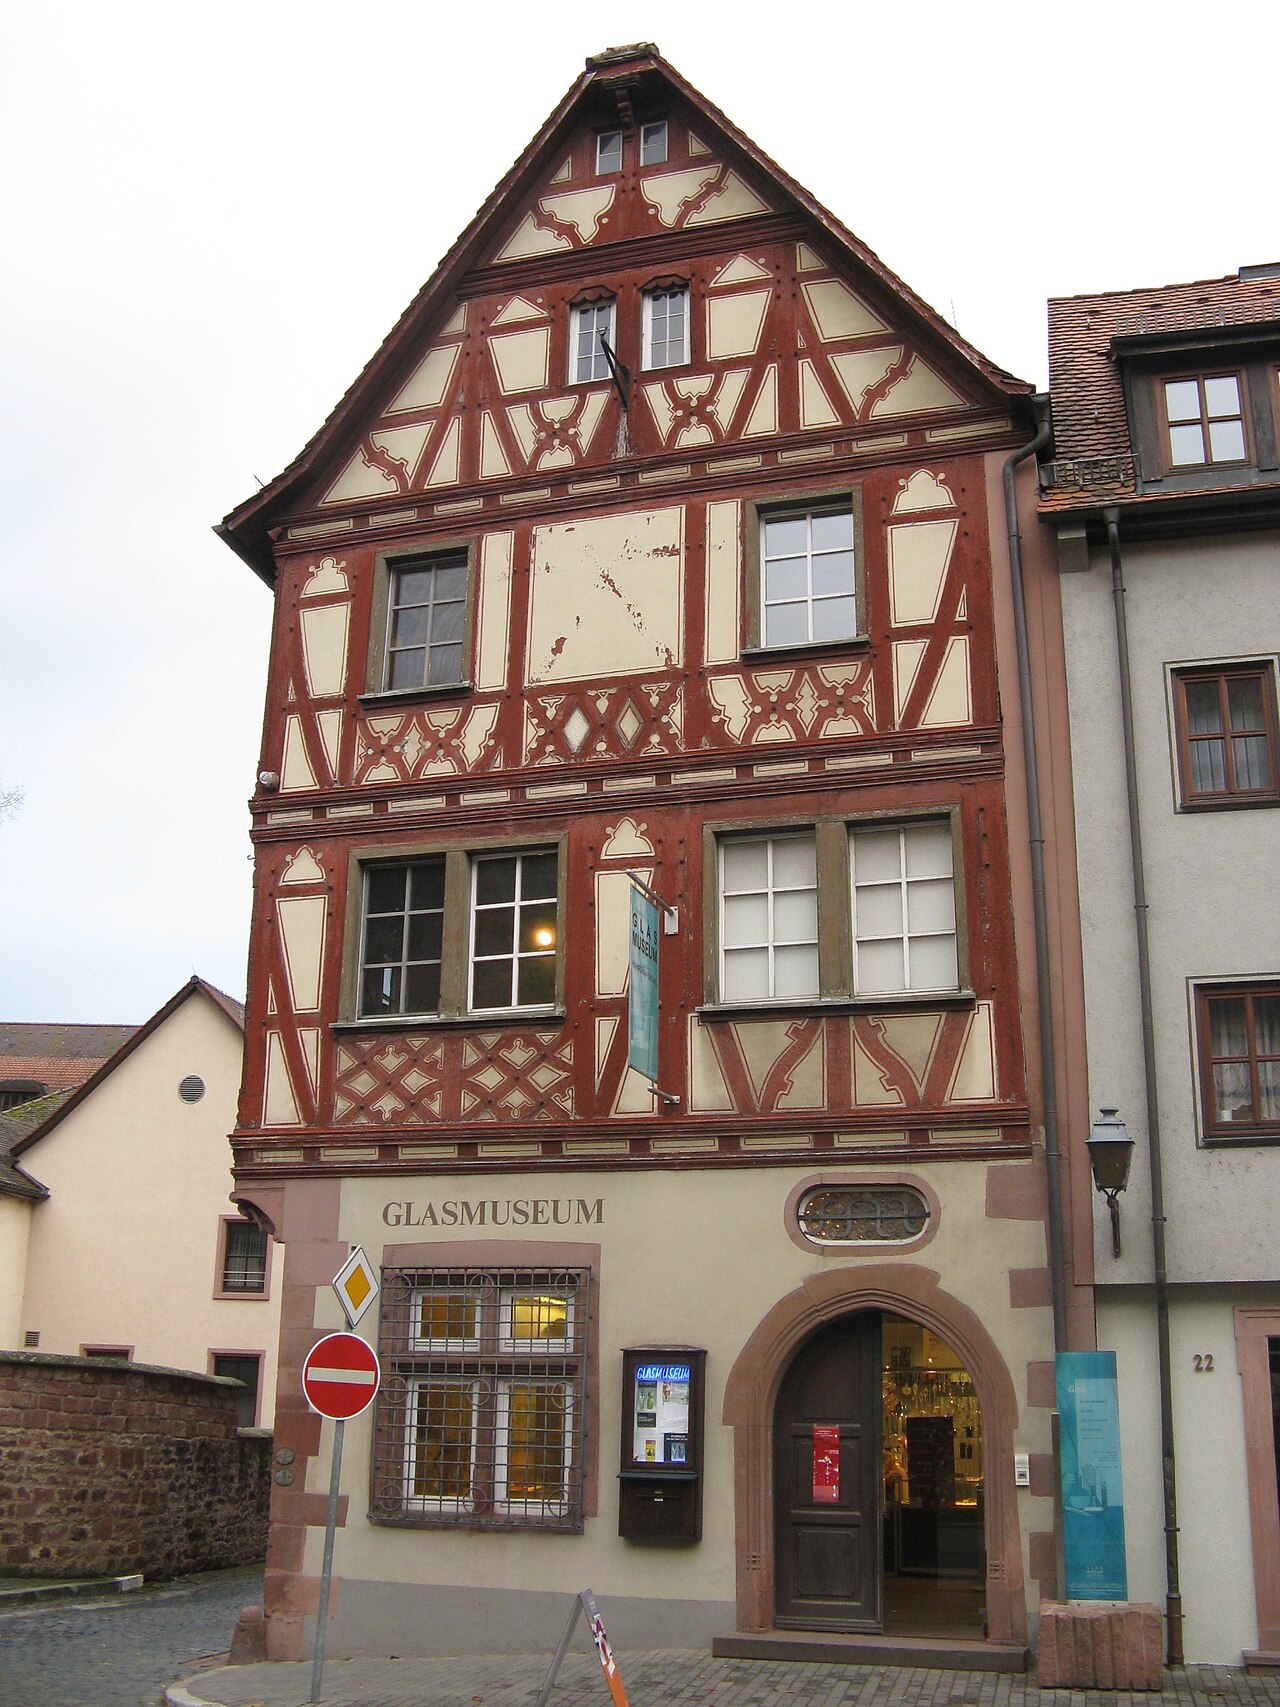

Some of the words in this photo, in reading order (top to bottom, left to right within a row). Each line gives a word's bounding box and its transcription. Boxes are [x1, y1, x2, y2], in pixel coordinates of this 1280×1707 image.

[632, 912, 658, 945] GLAS
[632, 930, 658, 964] MUSEUM
[382, 1198, 605, 1227] GLASMUSEUM
[637, 1367, 690, 1379] GLASMUSEUM
[1193, 1353, 1215, 1373] 22
